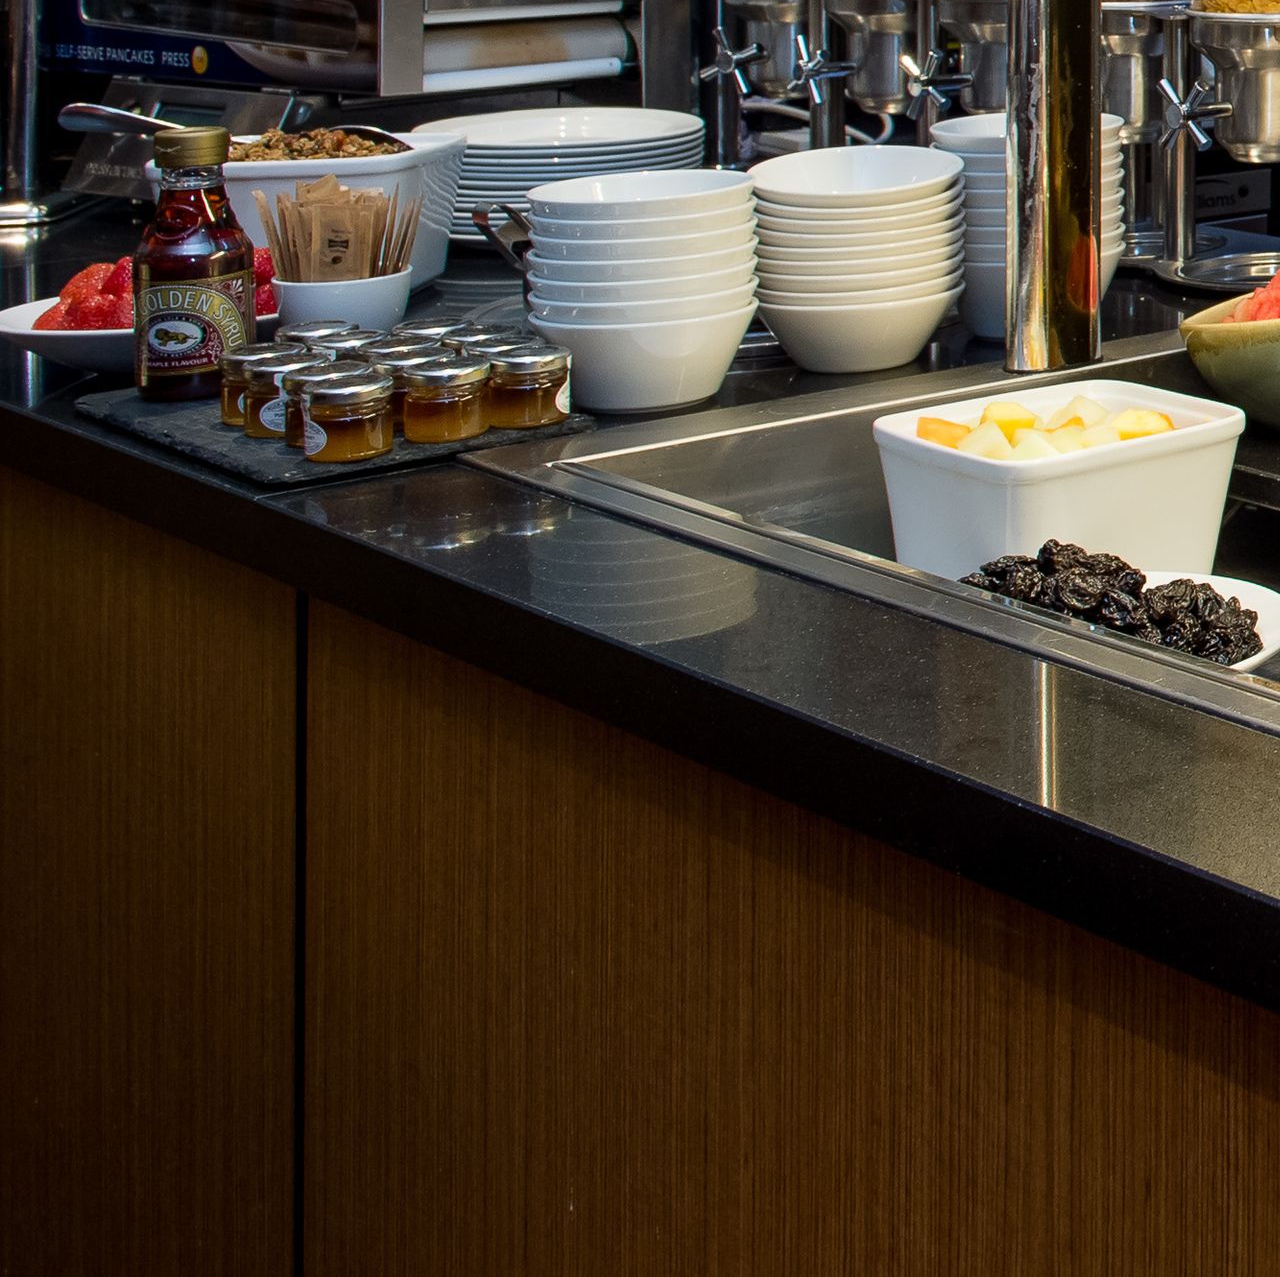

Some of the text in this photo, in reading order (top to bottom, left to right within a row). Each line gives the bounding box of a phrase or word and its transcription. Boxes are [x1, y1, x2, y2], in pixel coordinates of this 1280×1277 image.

[106, 47, 155, 65] PANCAKES
[161, 51, 190, 67] PRESS
[213, 302, 243, 348] SYRU
